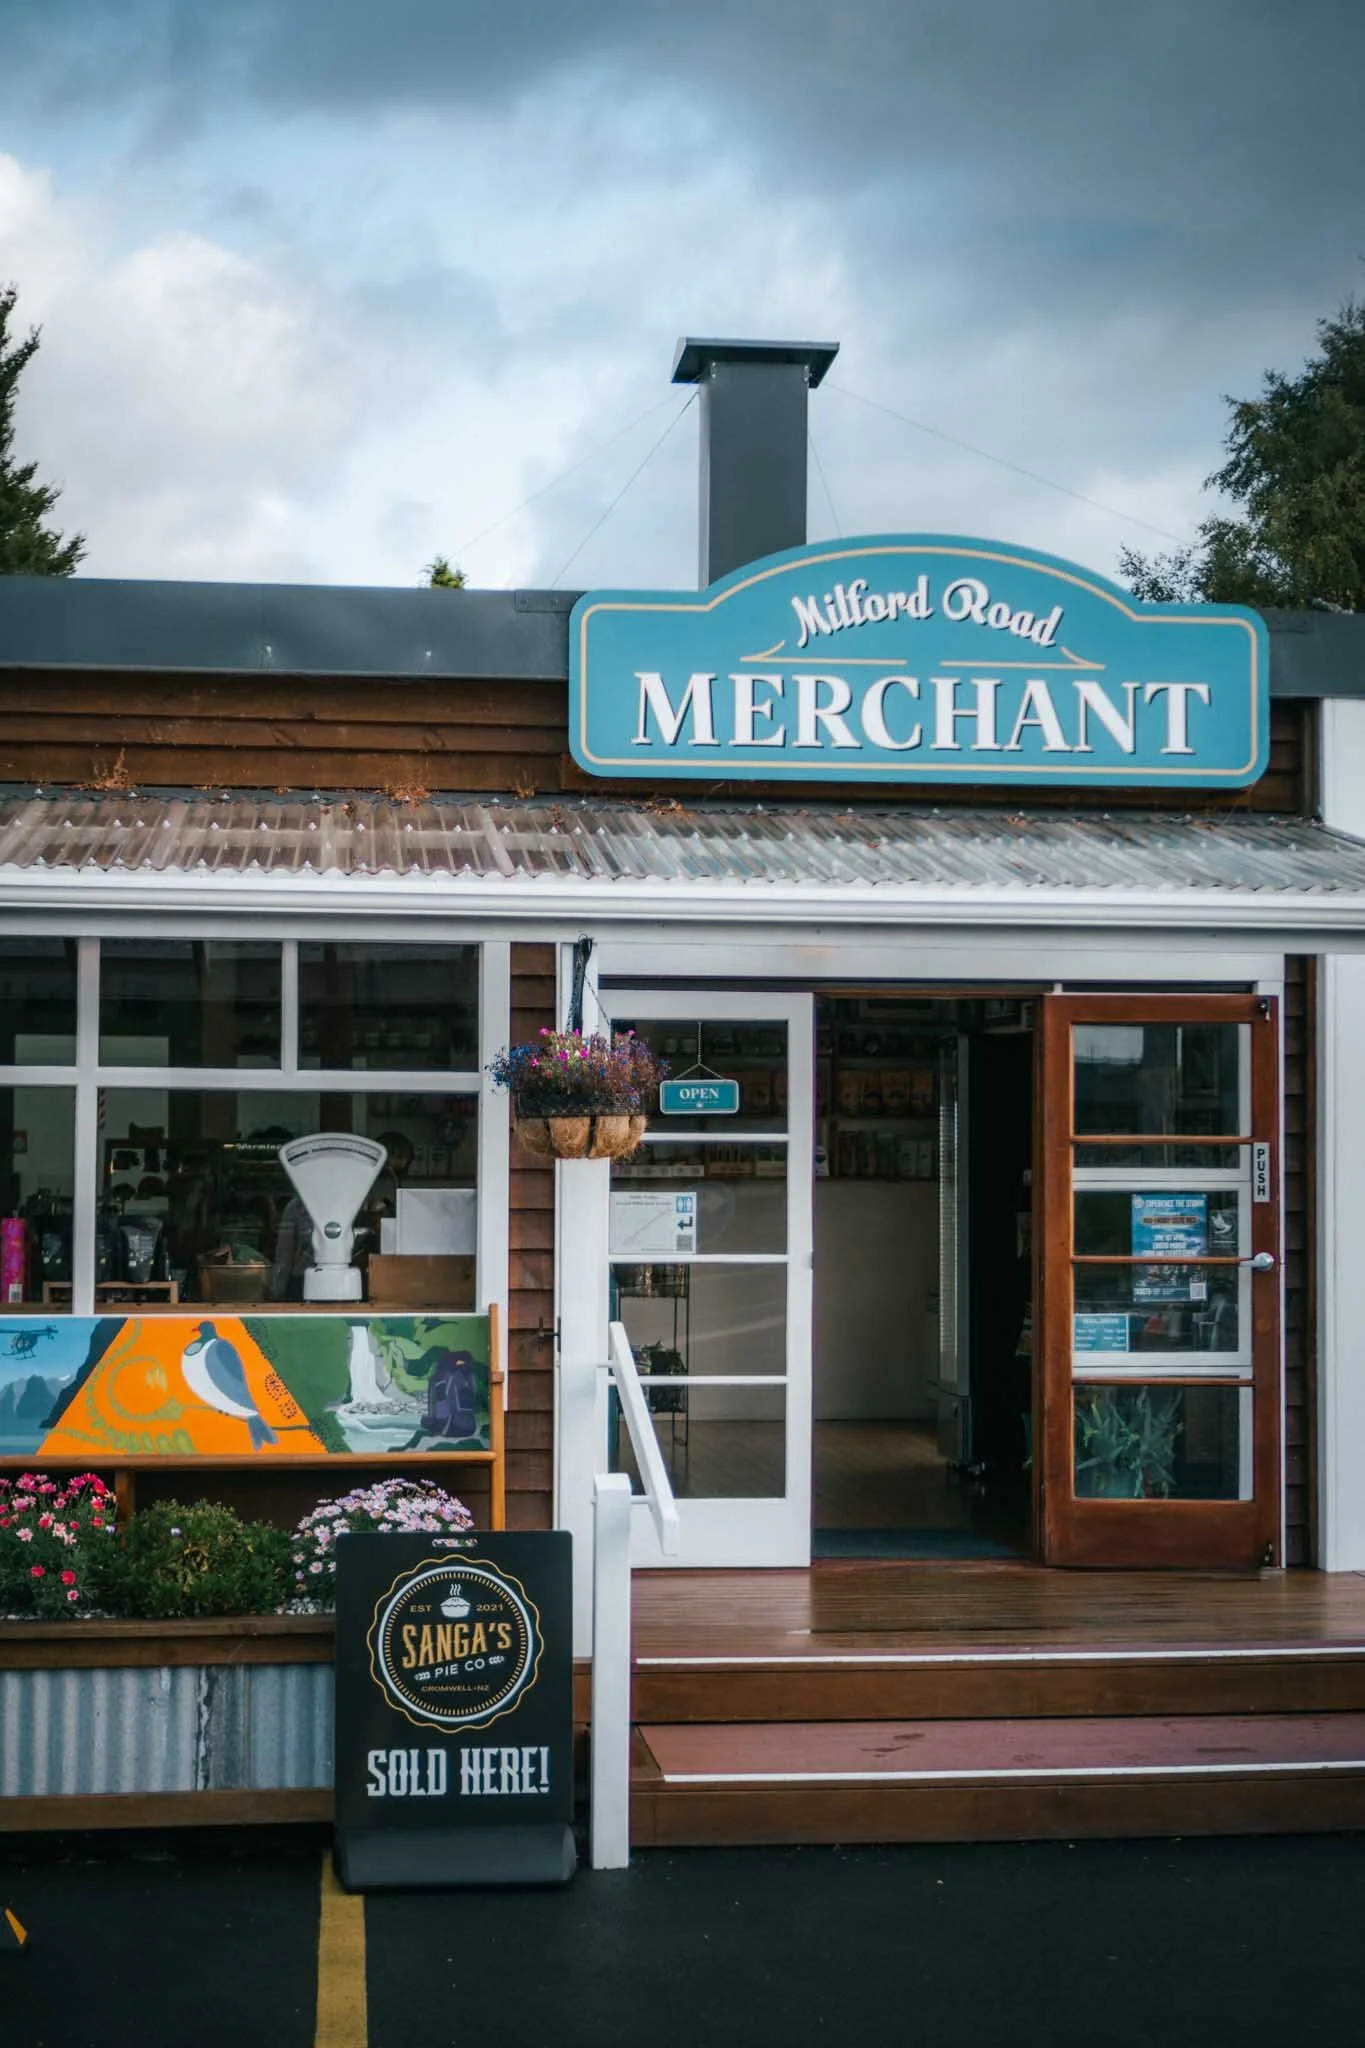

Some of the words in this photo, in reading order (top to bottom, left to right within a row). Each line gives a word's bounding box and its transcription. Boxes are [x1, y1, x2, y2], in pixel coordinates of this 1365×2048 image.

[792, 574, 934, 648] Milford
[942, 576, 1064, 648] Road
[631, 671, 1211, 756] MERCHANT
[679, 1087, 720, 1100] OPEN
[1256, 1147, 1266, 1197] PUSH
[410, 1604, 433, 1613] EST
[475, 1603, 504, 1612] 2021
[401, 1621, 513, 1670] SANGA'S
[434, 1663, 459, 1679] PIE
[464, 1657, 486, 1672] CO
[366, 1748, 448, 1797] SOLD
[459, 1746, 550, 1796] HERE!
